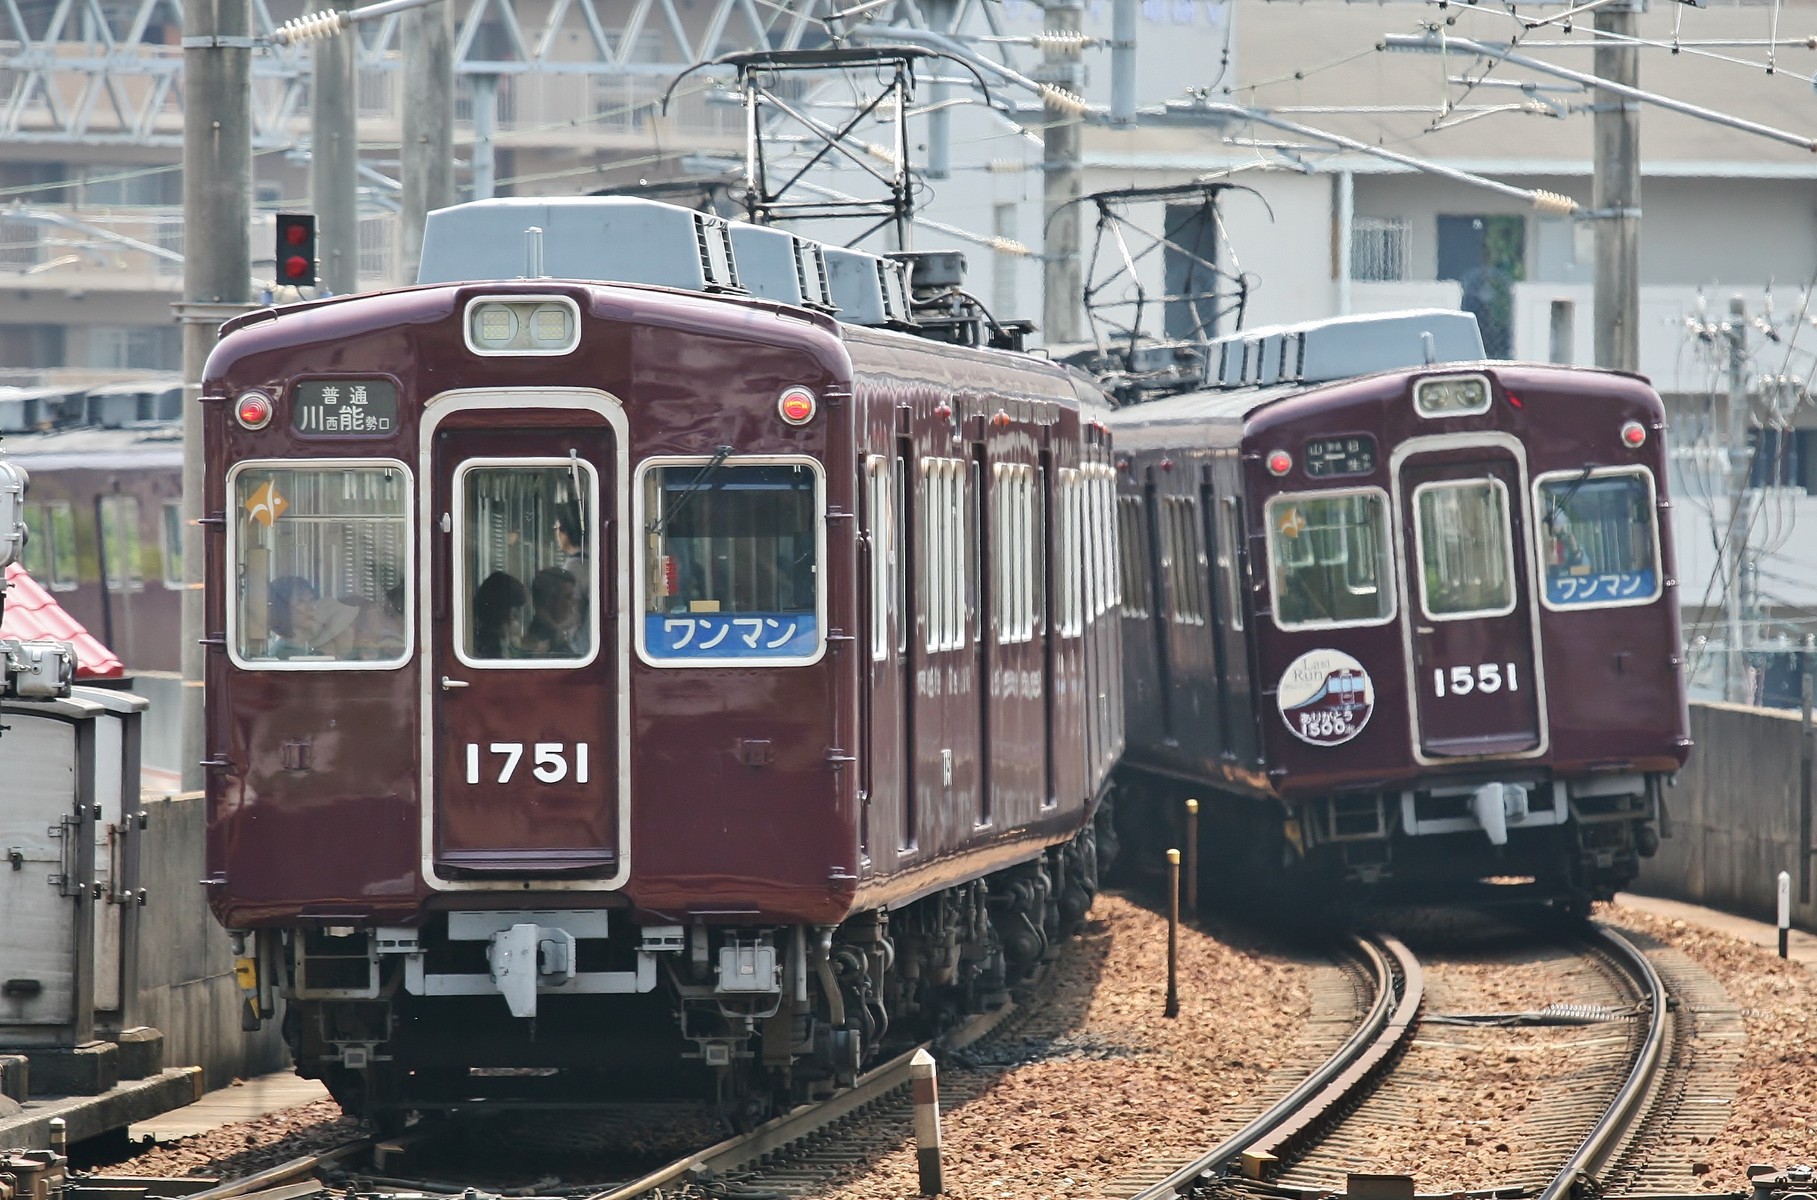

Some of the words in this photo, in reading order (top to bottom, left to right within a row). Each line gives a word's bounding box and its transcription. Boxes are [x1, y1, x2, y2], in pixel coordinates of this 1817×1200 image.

[321, 385, 369, 405] 普通
[300, 405, 390, 431] 川西能勢口
[1557, 573, 1642, 600] ワンマン
[664, 618, 797, 650] ワンマン
[1294, 669, 1323, 682] Run
[1433, 662, 1519, 698] 1551
[466, 742, 589, 784] 1751
